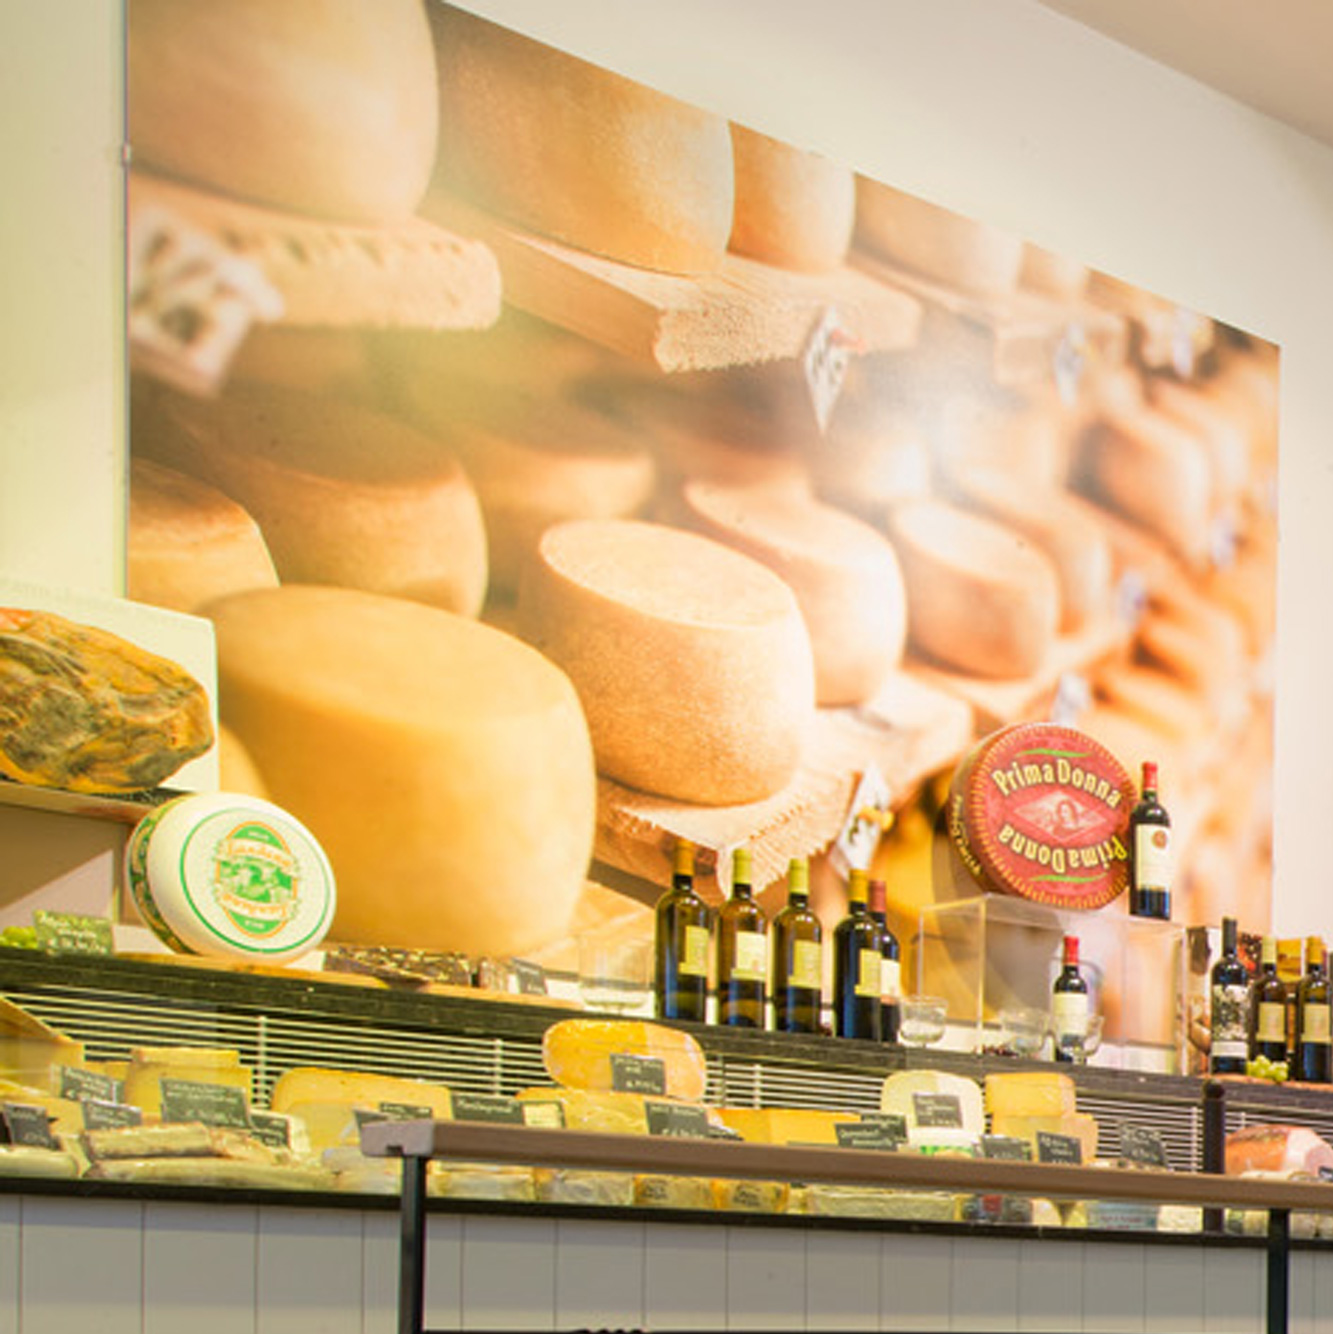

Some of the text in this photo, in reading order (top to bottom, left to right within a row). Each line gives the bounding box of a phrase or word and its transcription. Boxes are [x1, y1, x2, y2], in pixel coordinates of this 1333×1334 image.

[991, 758, 1122, 809] Prima Donna
[998, 823, 1066, 873] Donna
[1066, 836, 1128, 869] Prima
